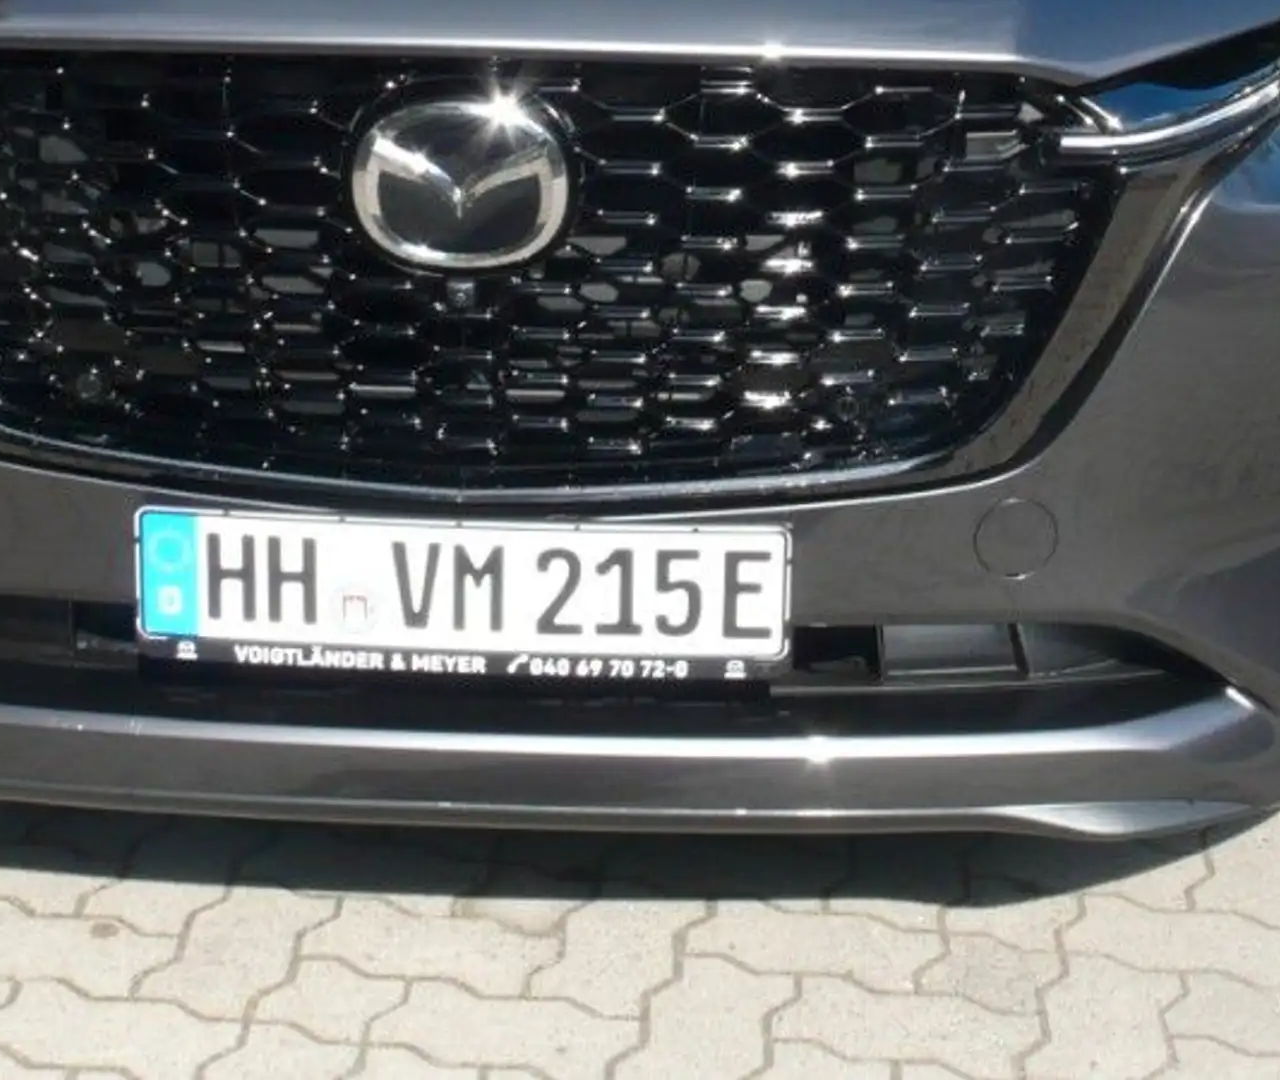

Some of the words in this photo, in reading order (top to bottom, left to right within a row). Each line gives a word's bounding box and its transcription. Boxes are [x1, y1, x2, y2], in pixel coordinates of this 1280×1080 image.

[206, 533, 317, 624] HH
[392, 540, 504, 631] VM
[536, 548, 772, 639] 215E
[234, 644, 384, 671] VOIGTLÄNDER
[391, 652, 406, 671] &
[411, 654, 486, 674] MEYER
[529, 656, 569, 676] 040
[575, 657, 603, 677] 69
[609, 659, 634, 678] 70
[640, 659, 689, 680] 72-0
